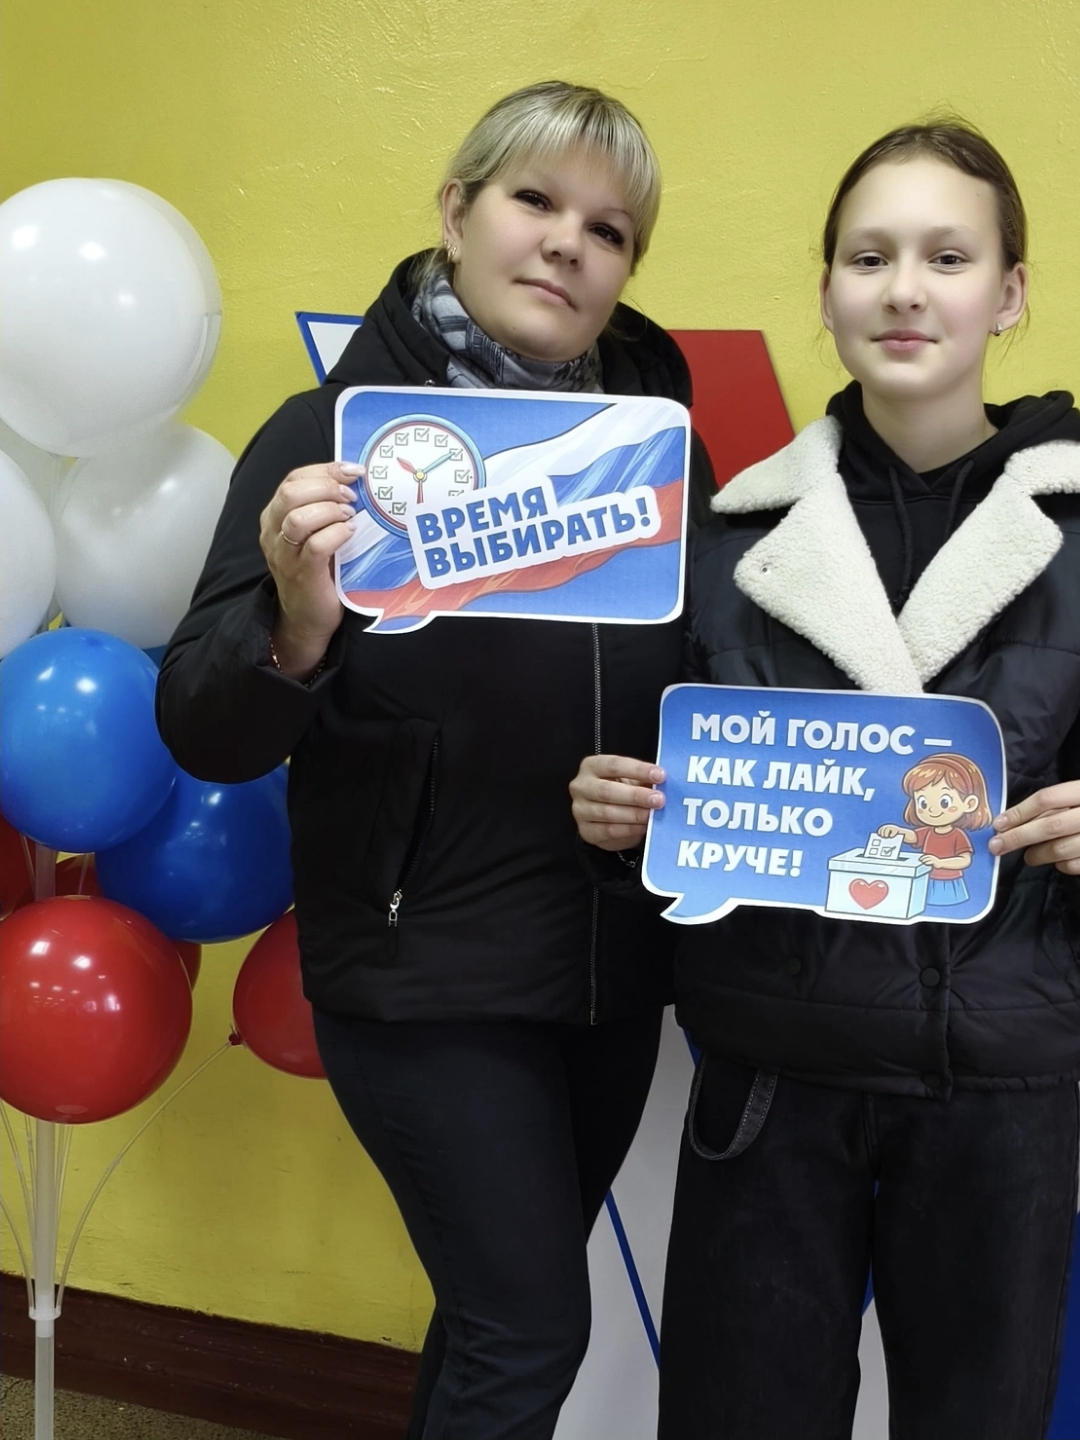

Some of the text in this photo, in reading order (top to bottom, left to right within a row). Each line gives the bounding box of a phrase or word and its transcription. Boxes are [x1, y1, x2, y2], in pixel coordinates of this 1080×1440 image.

[416, 486, 547, 544] ВРЕМЯ
[424, 497, 651, 579] ВЫБИРАТЬ!
[692, 710, 915, 755] МОЙ ГОЛОС
[687, 756, 875, 801] КАК ЛАЙК,
[683, 798, 833, 836] ТОЛЬКО
[677, 841, 803, 877] КРУЧЕ!
